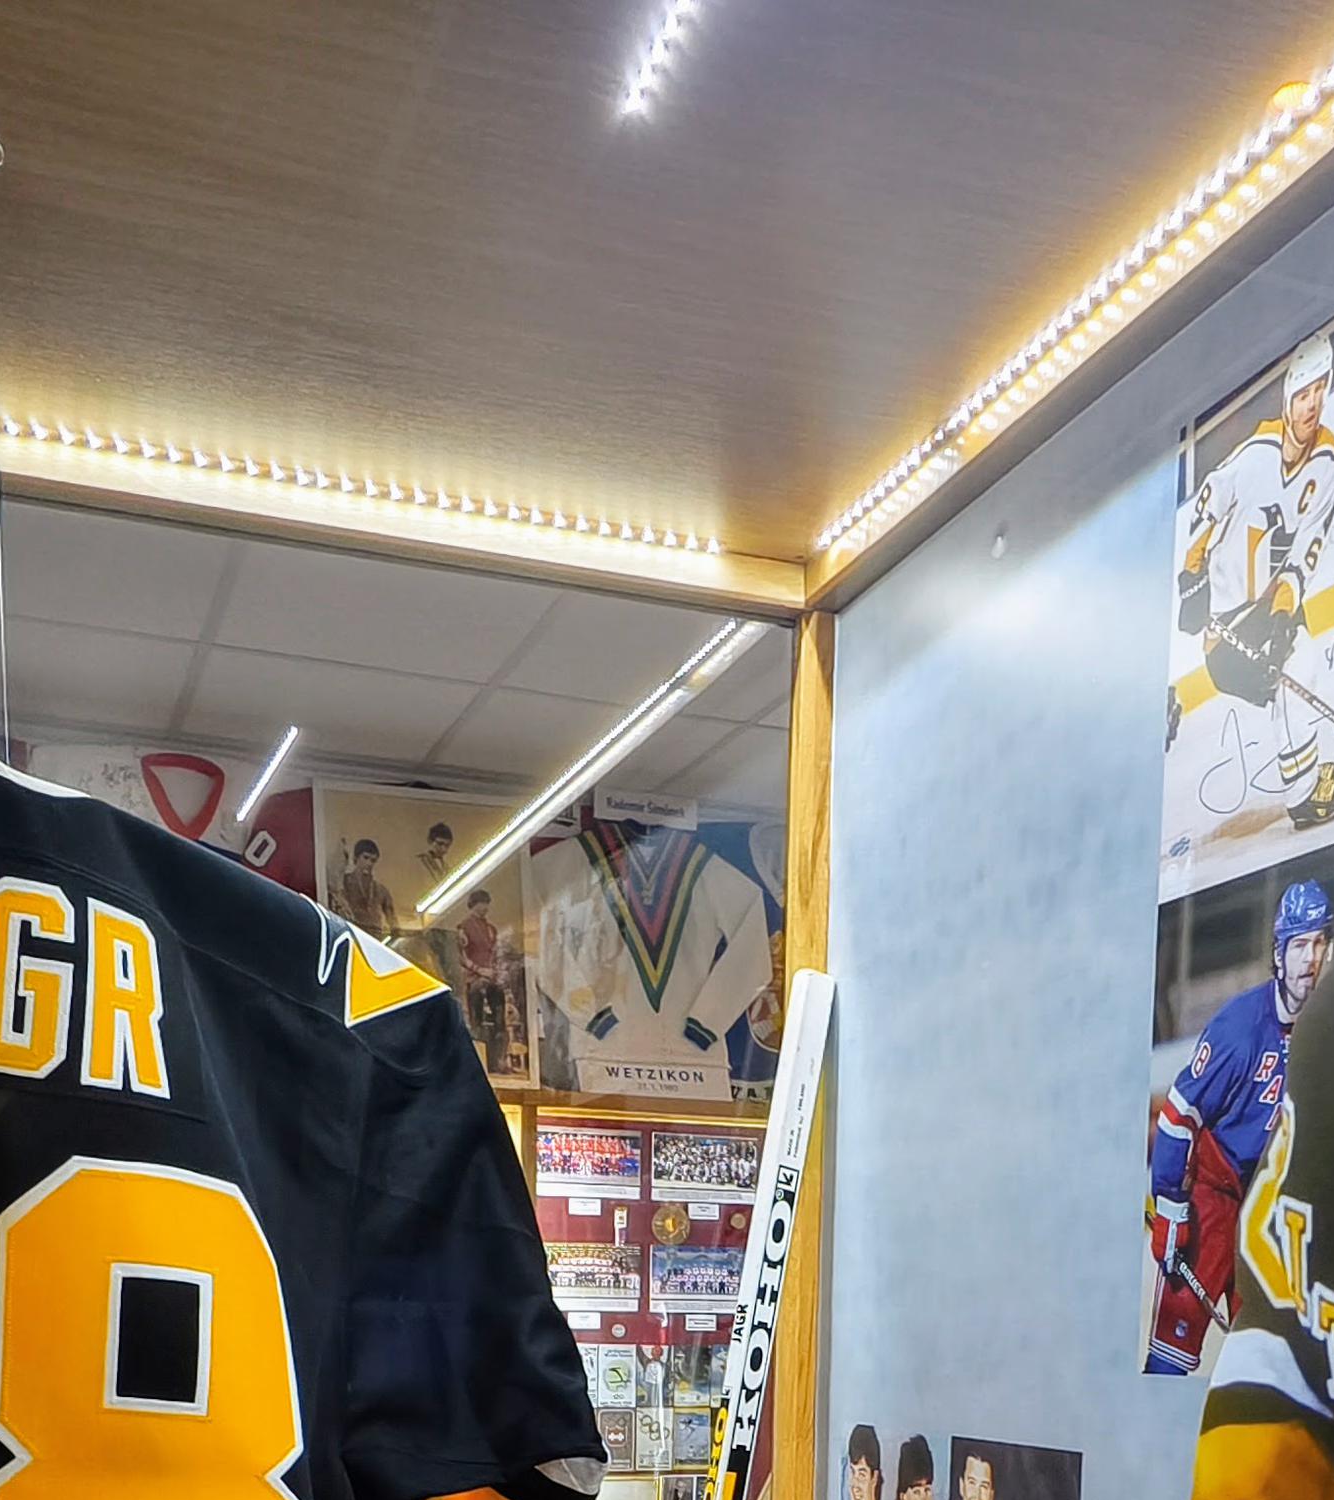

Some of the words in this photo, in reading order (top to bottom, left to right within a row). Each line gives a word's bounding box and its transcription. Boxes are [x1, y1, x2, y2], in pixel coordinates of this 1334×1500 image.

[1297, 478, 1316, 515] C
[1304, 536, 1322, 572] 6
[605, 1066, 705, 1083] WETZIKON
[1191, 1041, 1211, 1078] 8
[730, 1303, 749, 1344] JAGR
[730, 1200, 793, 1452] KOHO
